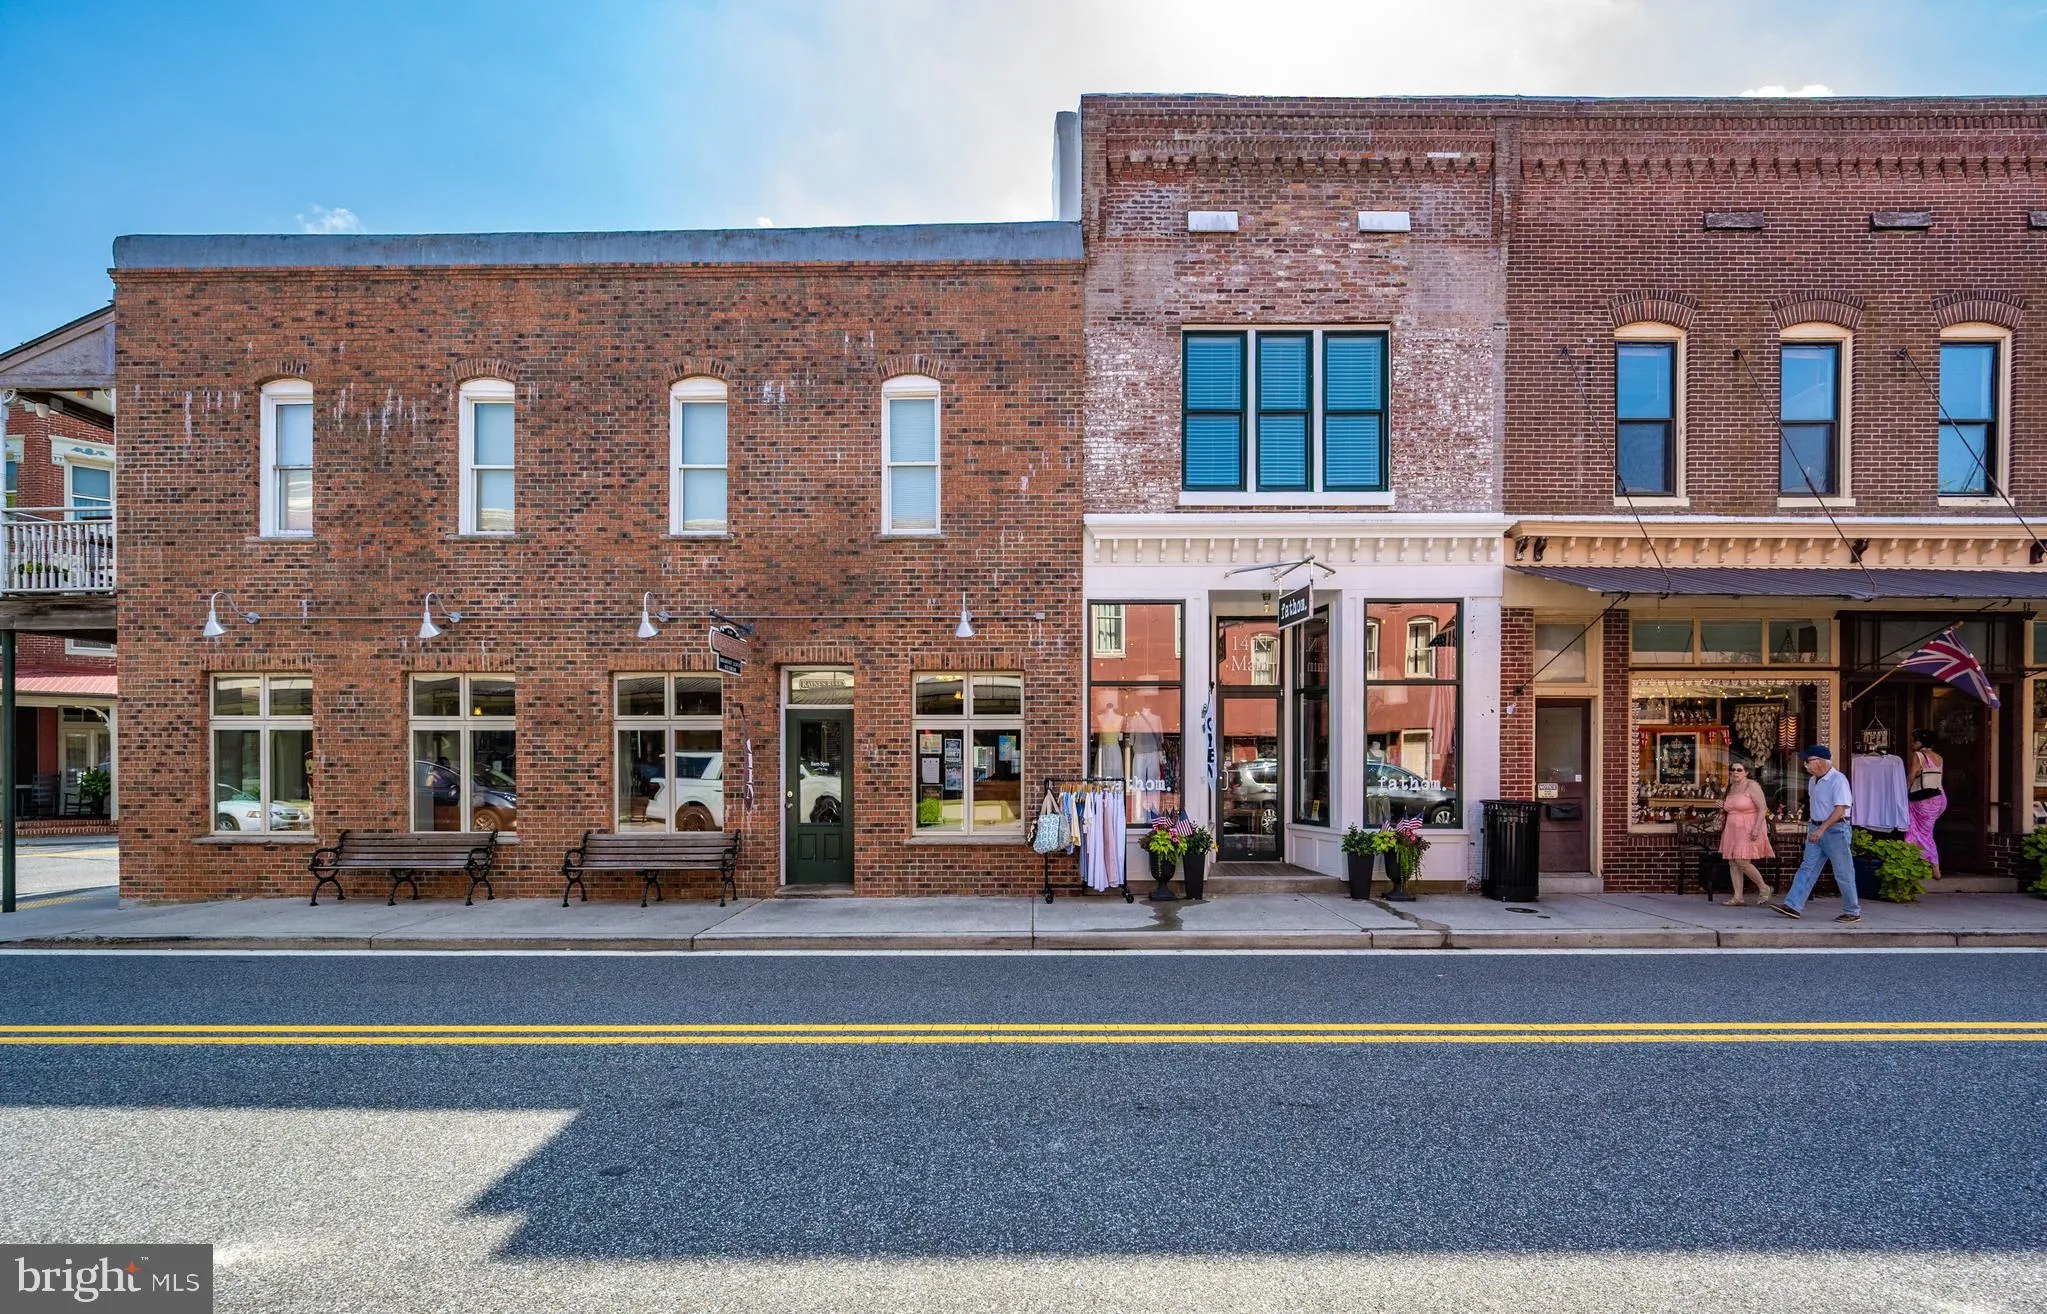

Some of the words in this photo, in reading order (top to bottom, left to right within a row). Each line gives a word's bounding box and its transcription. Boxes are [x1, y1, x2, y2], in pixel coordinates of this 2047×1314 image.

[1281, 598, 1307, 620] fathom.
[1232, 636, 1248, 651] 14
[1254, 636, 1271, 652] N.
[1231, 655, 1270, 672] Main
[1863, 730, 1888, 747] OPEN
[1377, 775, 1447, 792] fathom.
